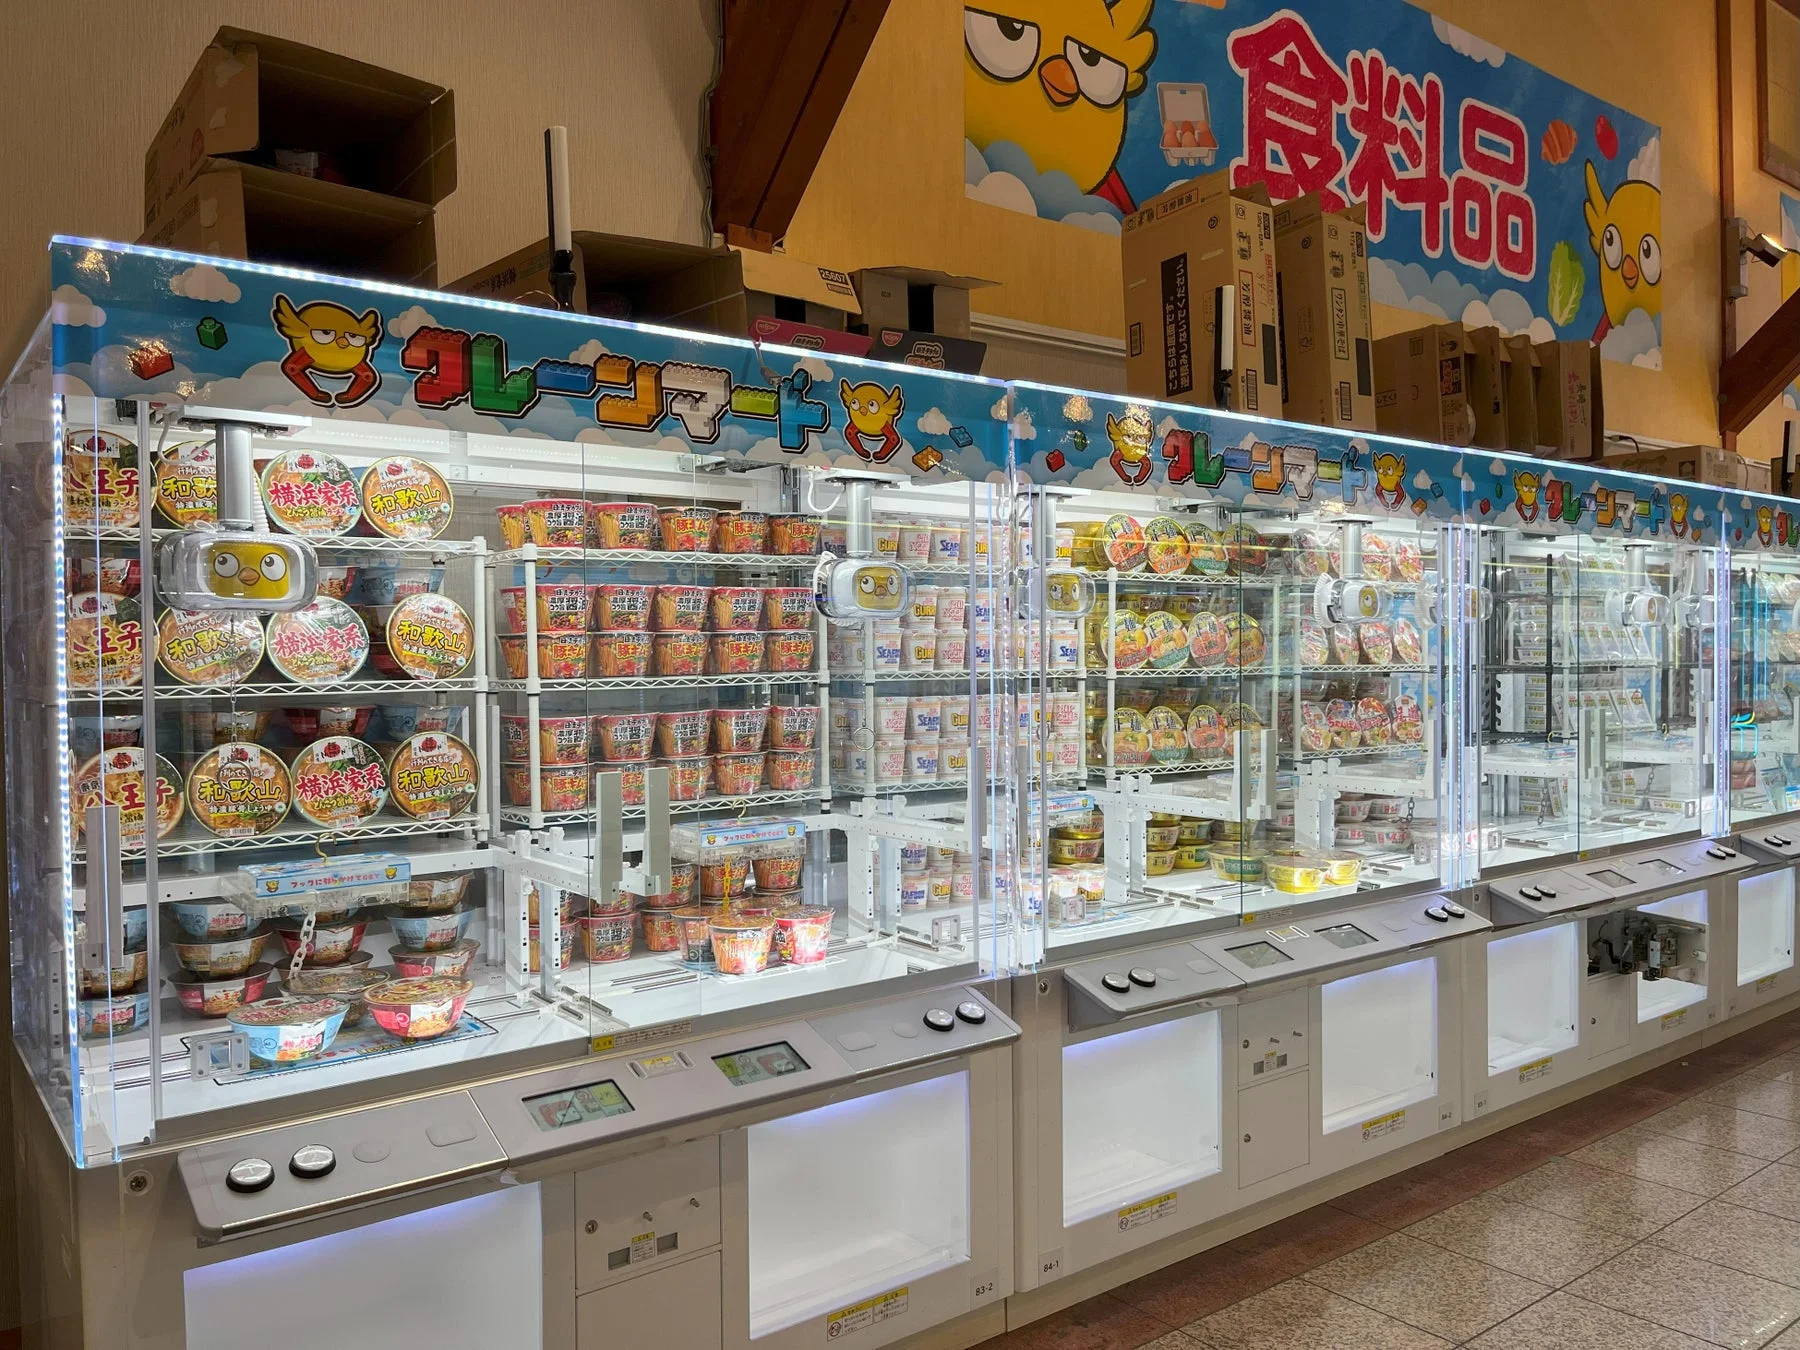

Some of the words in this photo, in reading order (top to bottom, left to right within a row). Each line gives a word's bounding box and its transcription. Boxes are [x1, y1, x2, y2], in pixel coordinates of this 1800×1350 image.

[1229, 9, 1536, 281] 食料品
[820, 269, 846, 283] 25607
[401, 326, 830, 453] クレーンマート
[1161, 429, 1367, 503] クレーンマート
[268, 480, 359, 507] 横浜家系
[371, 484, 442, 517] 和歌山
[1544, 480, 1667, 535] クレーンマート
[273, 624, 365, 658] 横浜家系
[398, 620, 465, 654] 和歌山
[199, 779, 281, 804] 和歌山
[296, 763, 386, 800] 横浜家系
[398, 763, 470, 791] 和歌山
[1043, 1260, 1060, 1273] 84-1
[975, 1282, 994, 1297] 83-2
